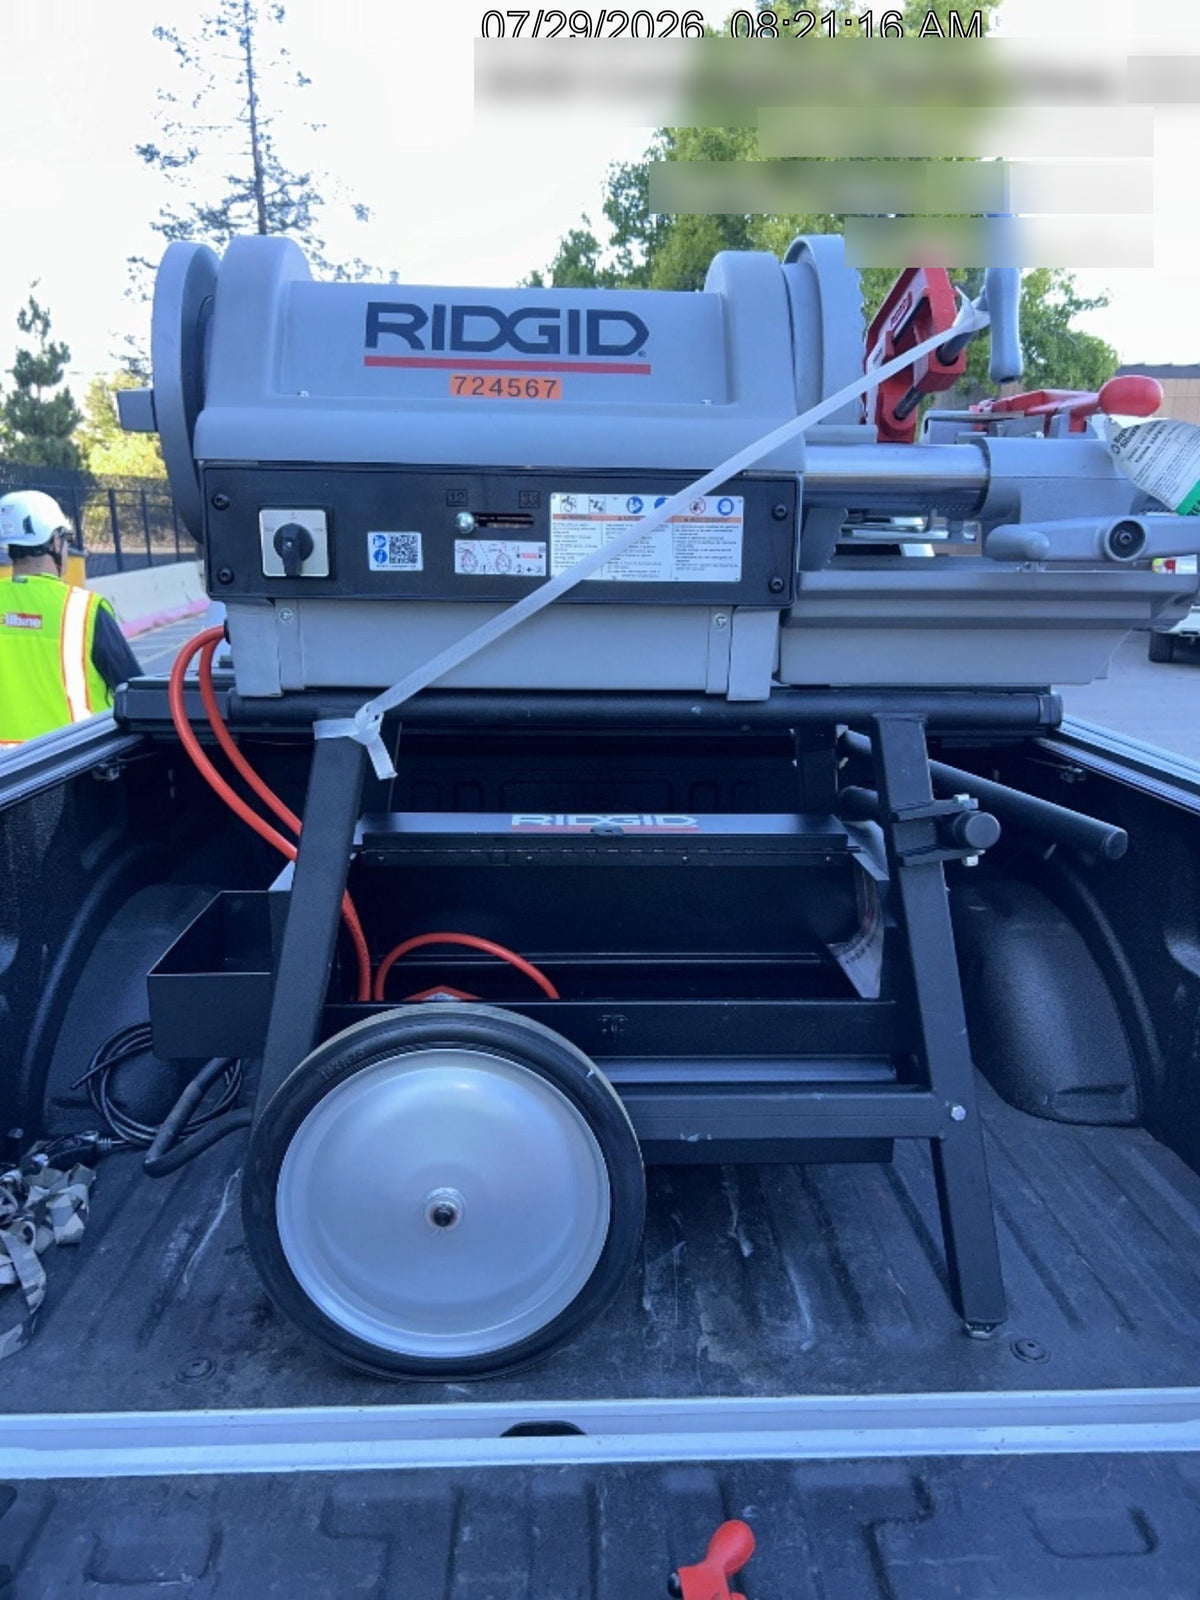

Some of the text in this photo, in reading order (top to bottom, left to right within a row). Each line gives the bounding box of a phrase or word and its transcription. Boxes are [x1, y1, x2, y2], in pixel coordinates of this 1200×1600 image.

[364, 302, 650, 356] RIDGID
[454, 376, 557, 398] 724567
[511, 814, 699, 826] RIDGID
